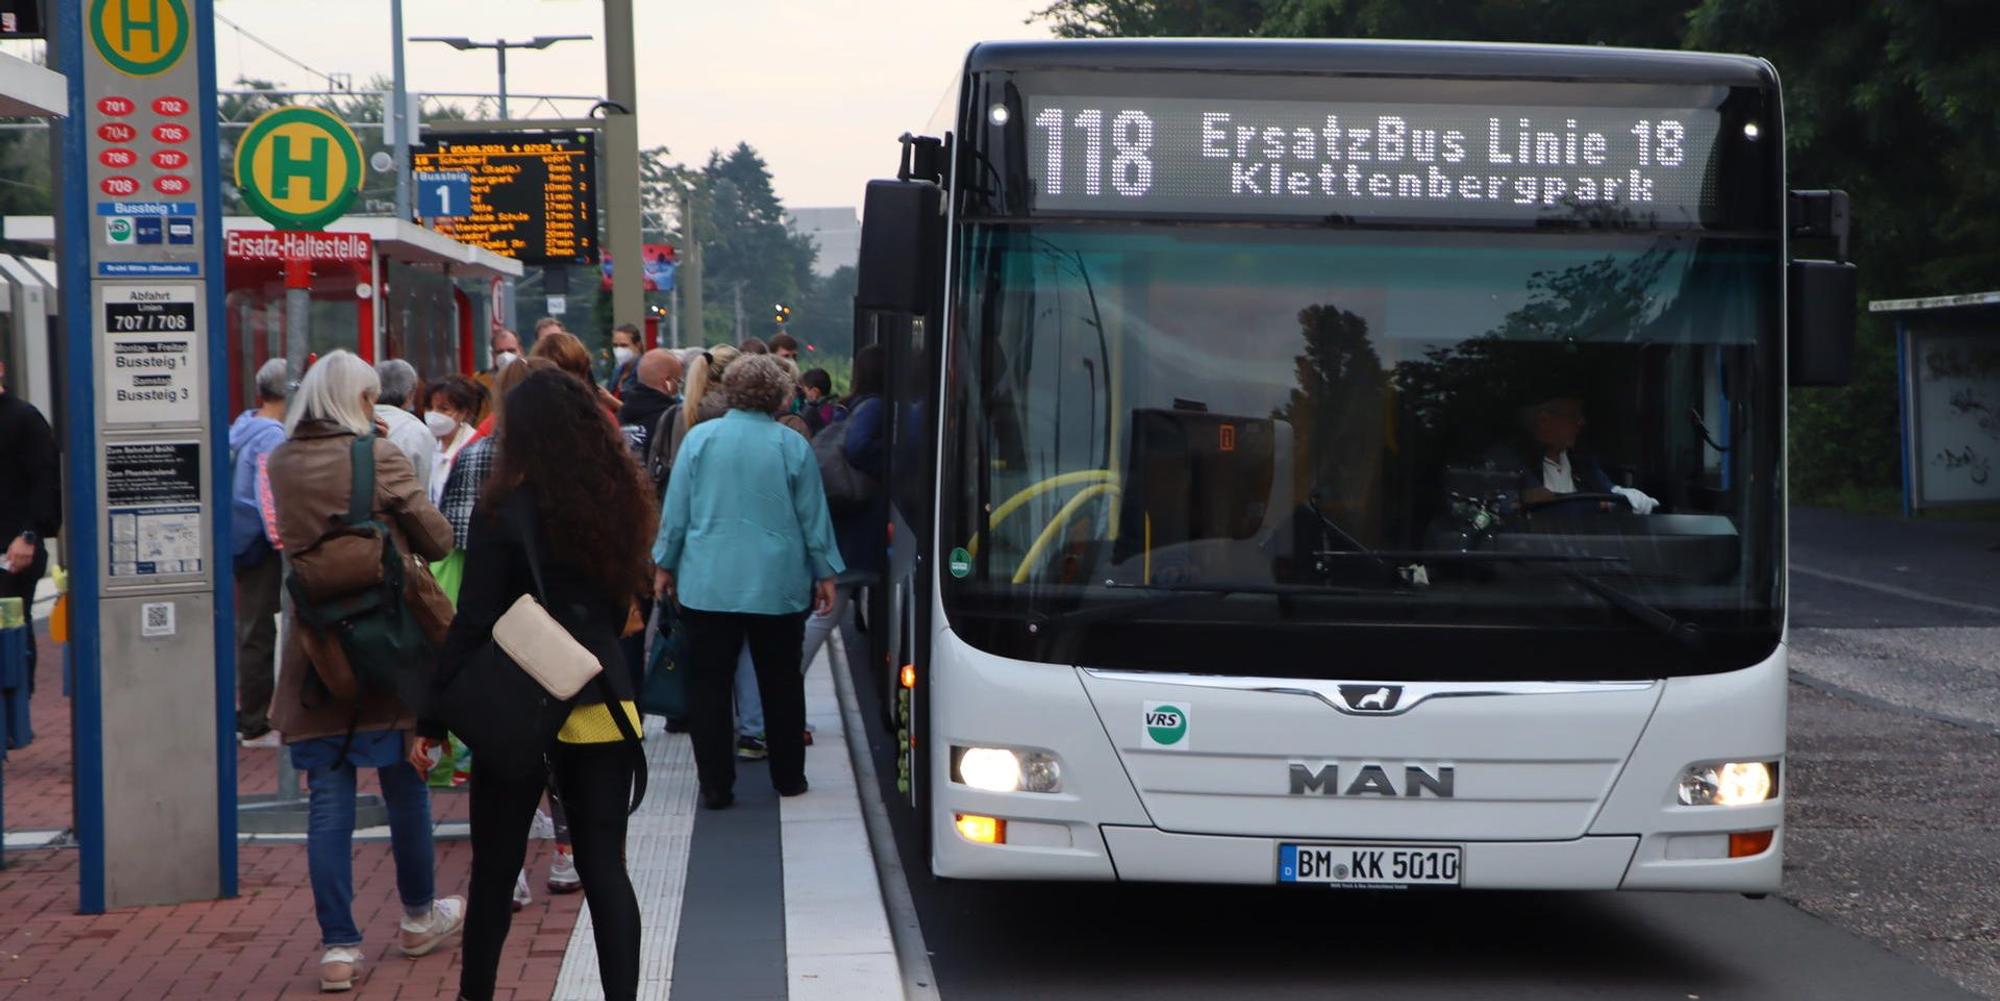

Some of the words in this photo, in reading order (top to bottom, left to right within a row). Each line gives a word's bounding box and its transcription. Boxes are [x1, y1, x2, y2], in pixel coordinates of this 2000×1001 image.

[105, 101, 127, 112] 701
[159, 101, 182, 113] 702
[105, 127, 128, 139] 704
[159, 128, 182, 140] 705
[1201, 112, 1466, 164] ErsatzBus
[1489, 118, 1607, 166] Linie
[1631, 120, 1685, 168] 18
[107, 152, 129, 164] 706
[159, 154, 181, 165] 707
[1036, 108, 1153, 196] 118
[271, 135, 329, 201] H
[419, 171, 468, 182] Bussteig
[1231, 160, 1655, 206] Klettenbergpark
[108, 180, 133, 193] 708
[436, 185, 449, 215] 1
[115, 202, 168, 215] Bussteig
[227, 231, 368, 259] Ersatz-Haltestelle
[130, 290, 171, 301] Abfahrt
[137, 303, 164, 312] Linien
[114, 315, 144, 330] 707
[157, 314, 187, 330] 708
[115, 355, 177, 370] Bussteig
[181, 355, 187, 366] 1
[116, 389, 178, 403] Bussteig
[181, 388, 189, 400] 3
[1146, 712, 1178, 727] VRS
[1288, 762, 1455, 799] MAN
[1285, 867, 1292, 876] D
[1299, 850, 1332, 878] BM
[1352, 851, 1385, 879] KK
[1393, 851, 1457, 880] 5010
